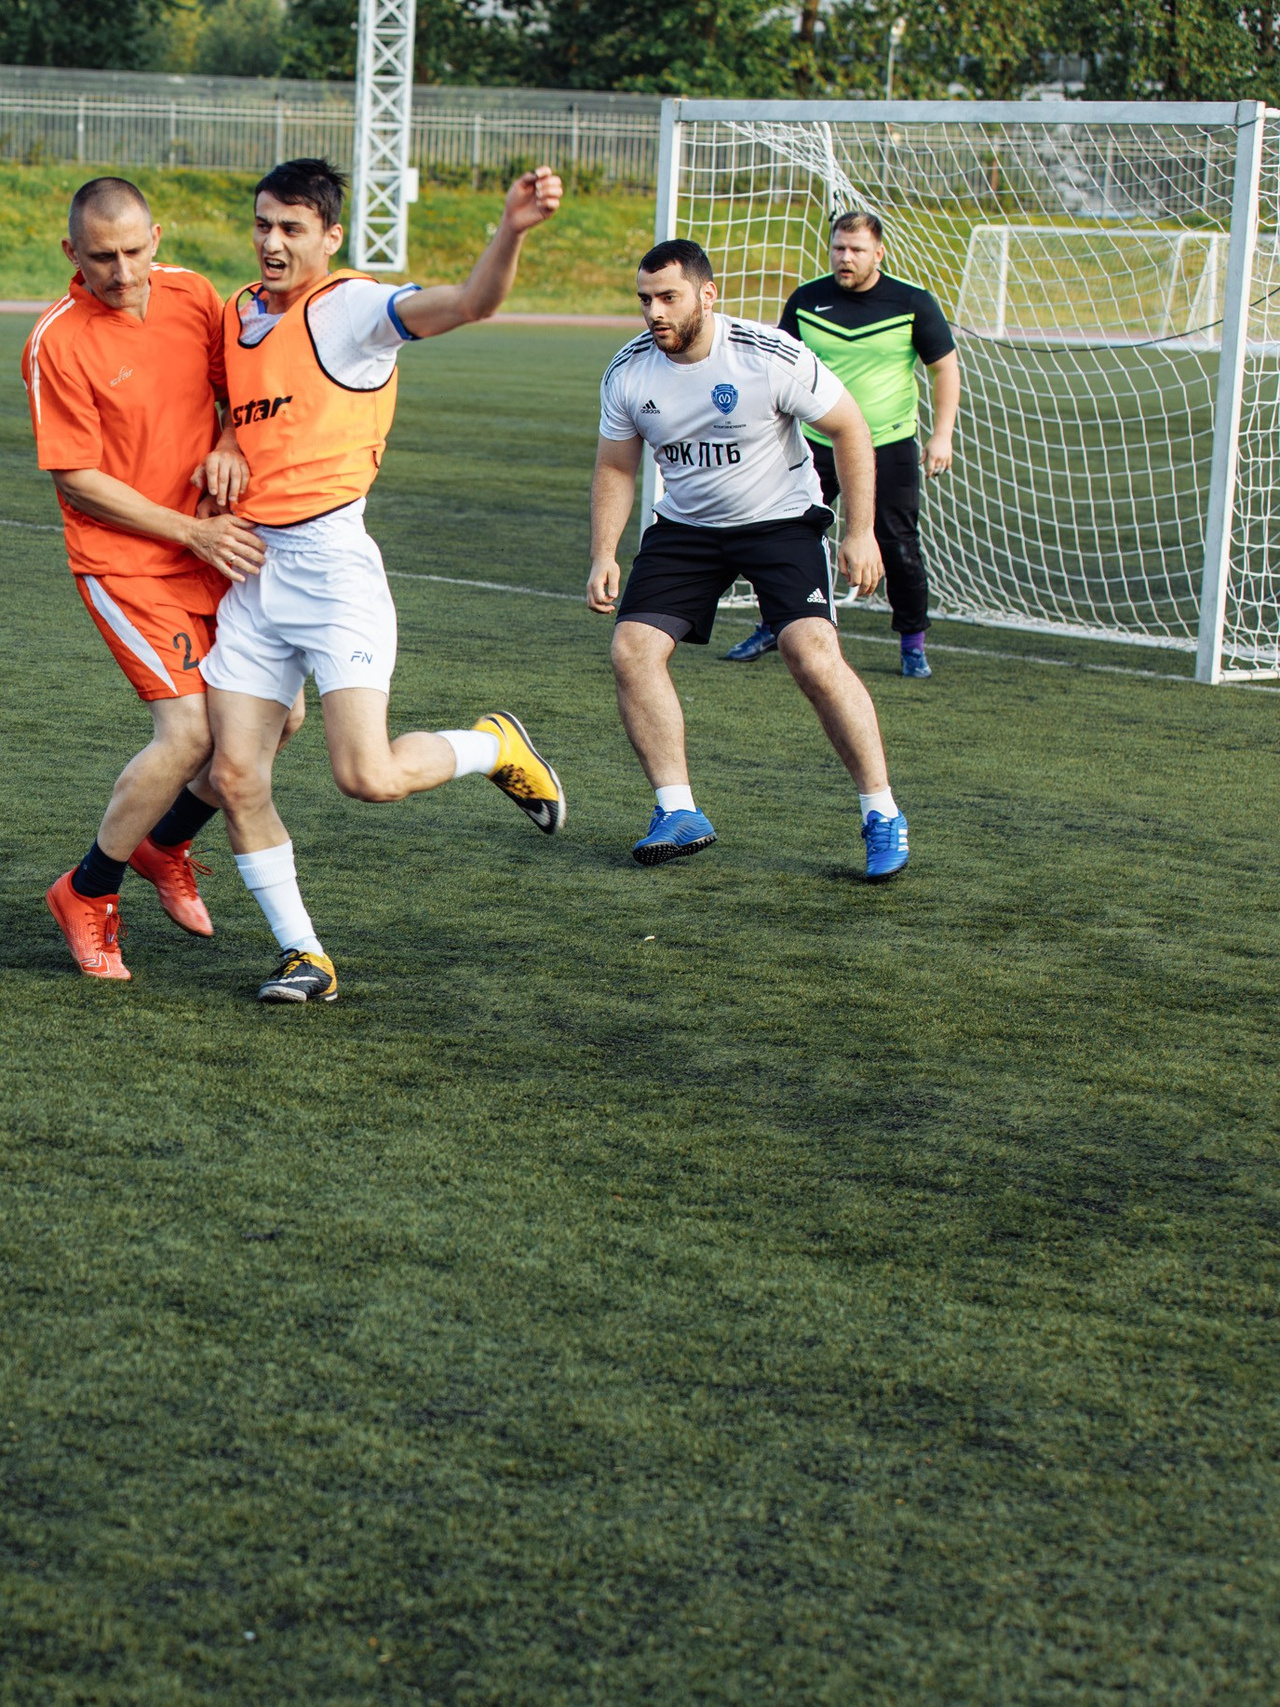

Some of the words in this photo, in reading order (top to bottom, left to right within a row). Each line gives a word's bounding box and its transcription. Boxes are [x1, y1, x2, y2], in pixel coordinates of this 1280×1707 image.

[232, 395, 293, 429] star
[699, 442, 741, 467] ПТБ
[173, 632, 199, 671] 2
